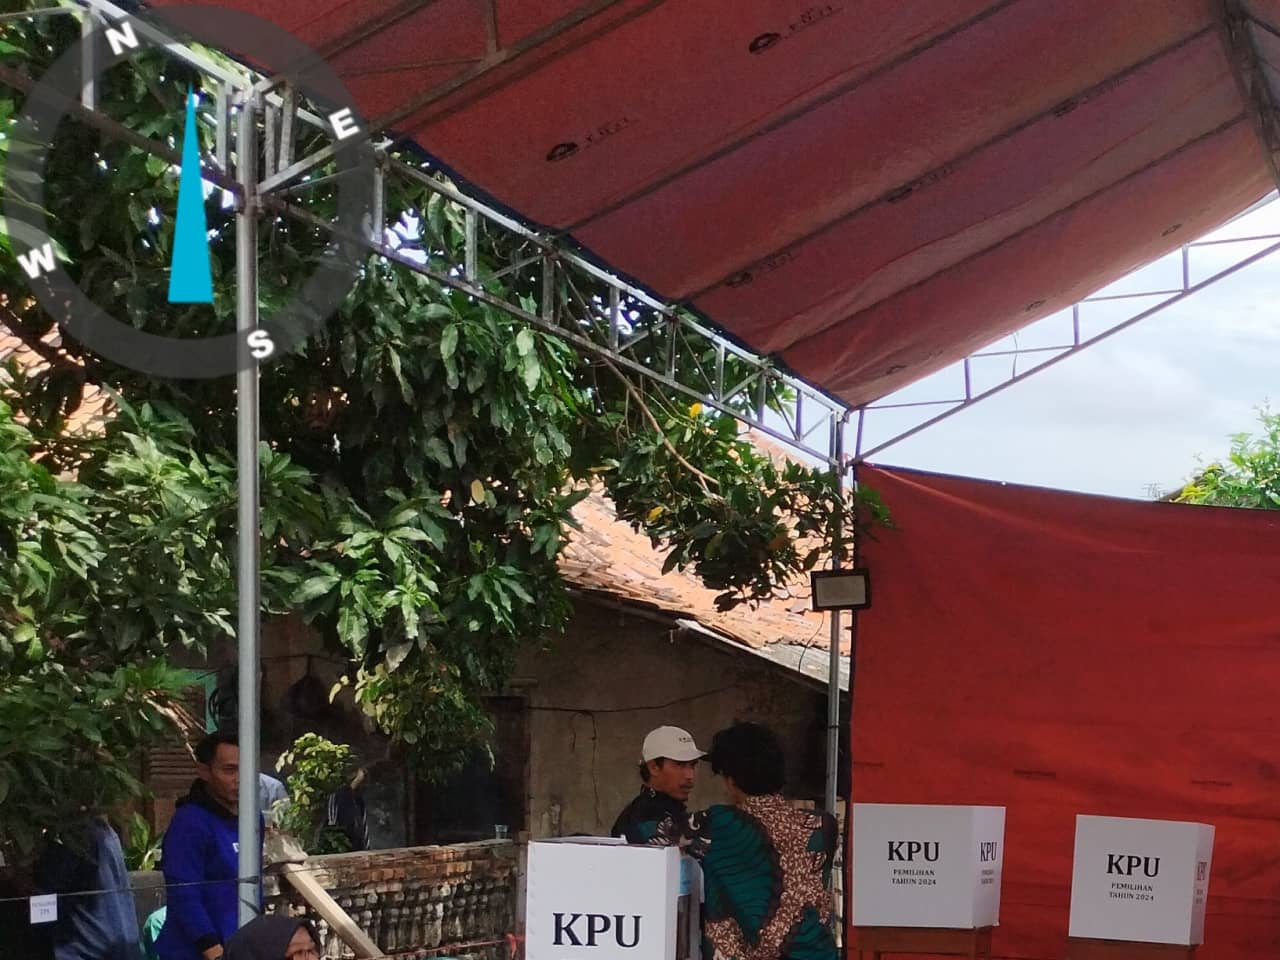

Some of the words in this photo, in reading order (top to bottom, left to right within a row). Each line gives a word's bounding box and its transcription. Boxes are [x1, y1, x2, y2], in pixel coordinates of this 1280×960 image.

[887, 840, 940, 862] KPU
[980, 841, 998, 862] KPU
[893, 868, 935, 876] PEMILIHAN
[1106, 854, 1161, 878] KPU
[891, 877, 917, 885] TAHUN
[917, 878, 937, 886] 2024
[1110, 882, 1154, 893] PEMILIHAN
[1108, 890, 1135, 901] TAHUN
[1136, 893, 1155, 902] 2024
[552, 912, 642, 948] KPU
